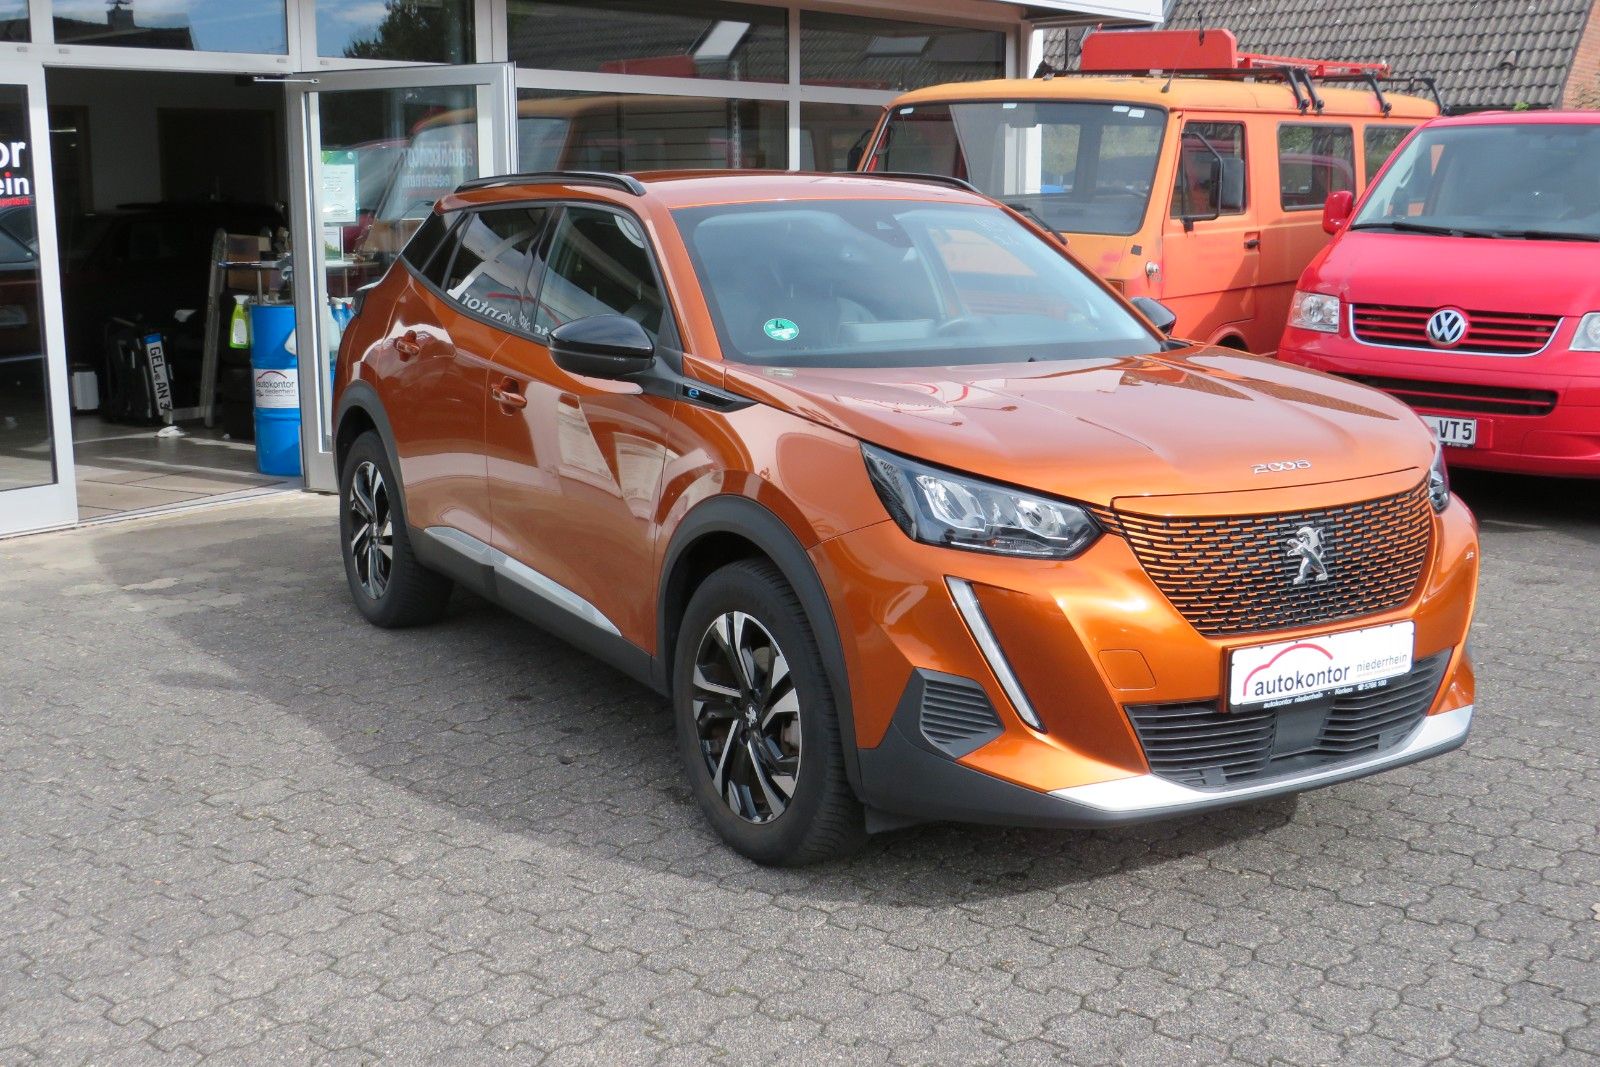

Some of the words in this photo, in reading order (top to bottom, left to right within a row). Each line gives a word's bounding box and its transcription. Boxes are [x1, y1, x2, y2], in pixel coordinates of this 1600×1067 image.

[149, 346, 164, 373] GEL
[155, 382, 169, 400] AN
[1250, 460, 1312, 475] 2008
[1255, 666, 1350, 696] autokontor
[1356, 652, 1408, 672] niederrhein
